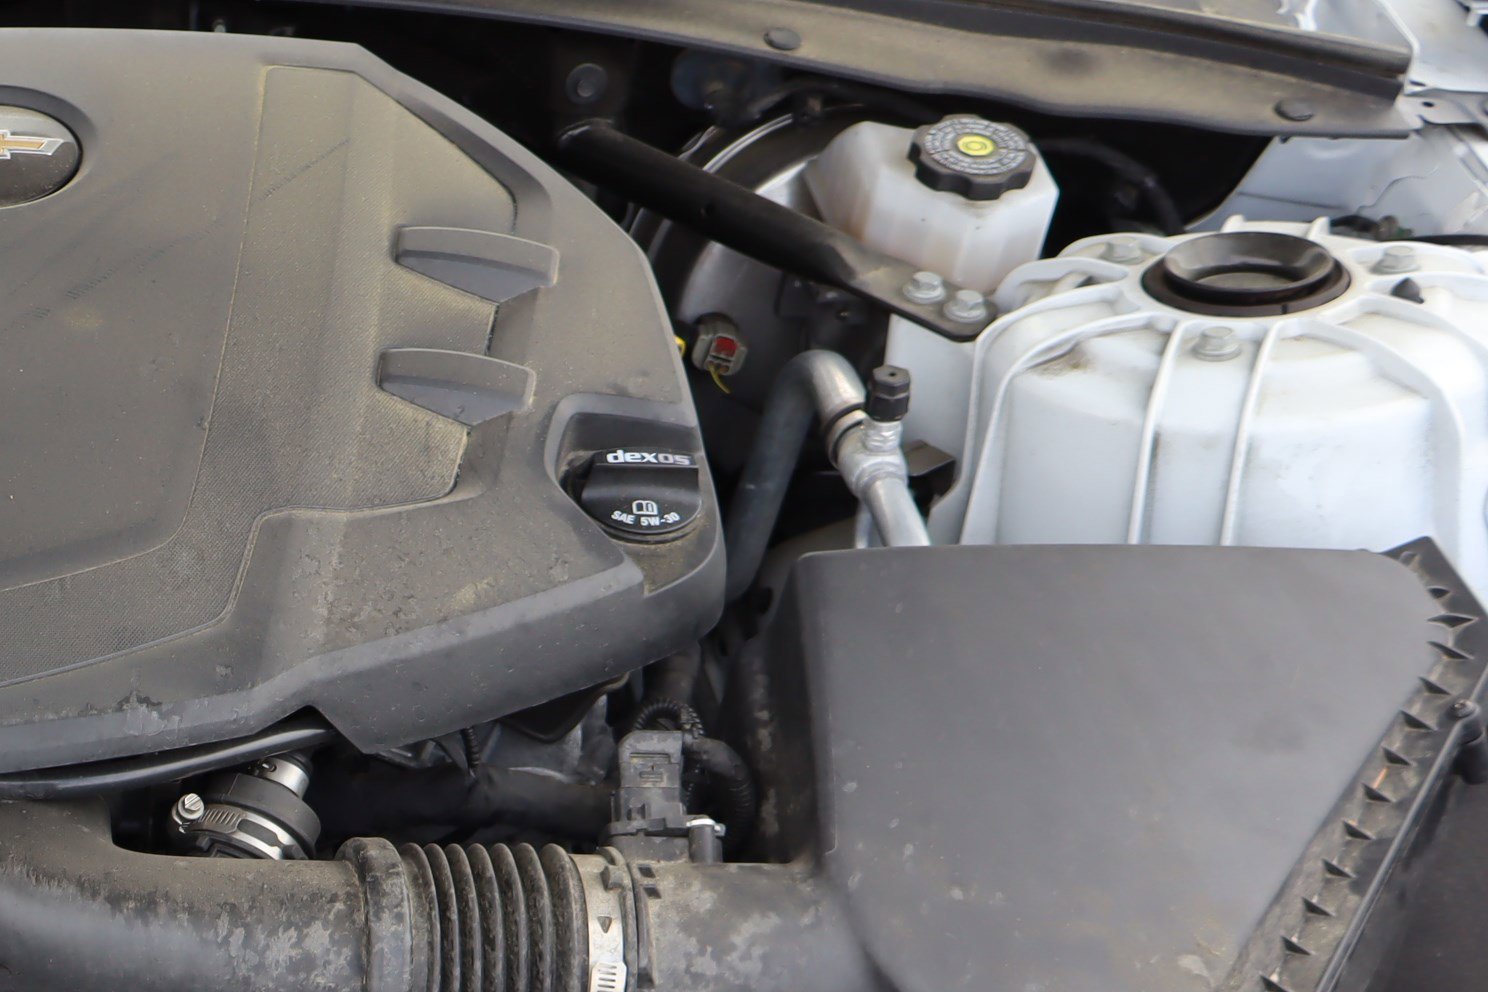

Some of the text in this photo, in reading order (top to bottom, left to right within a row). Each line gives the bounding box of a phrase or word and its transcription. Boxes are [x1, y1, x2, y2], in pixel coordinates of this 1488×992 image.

[606, 449, 691, 466] dexos
[611, 510, 680, 526] SAE 5W-30
